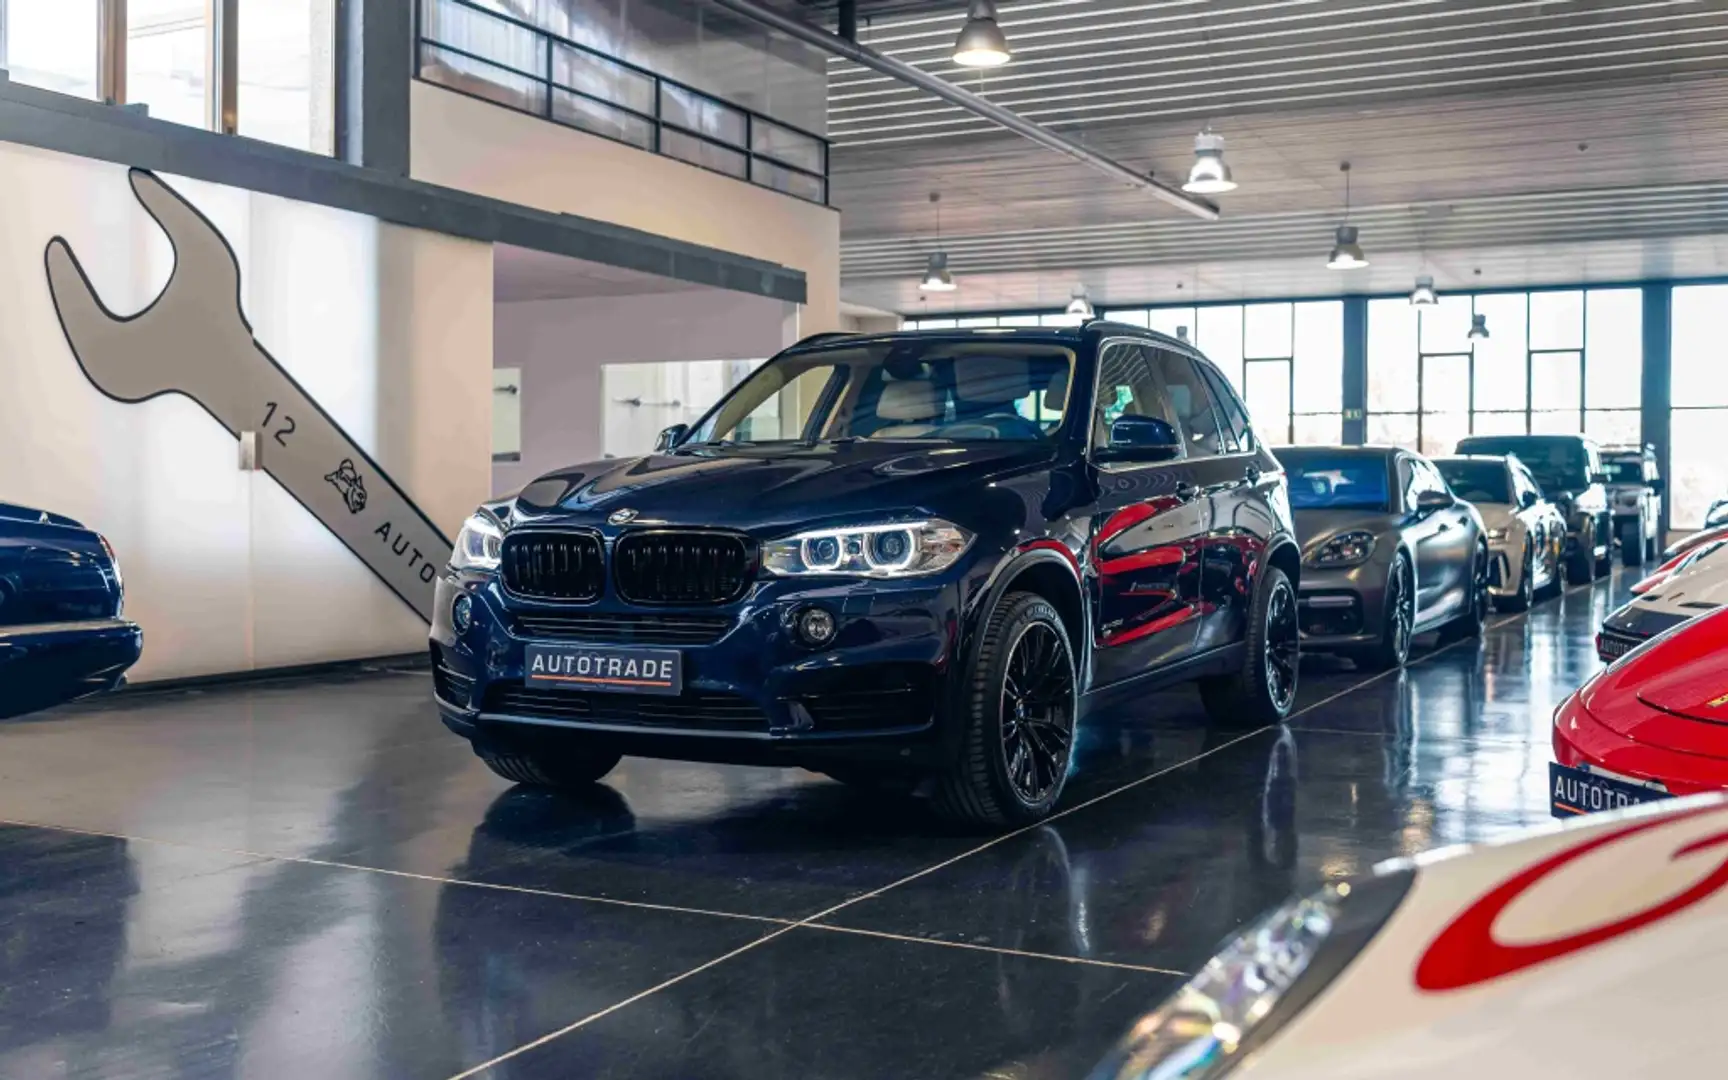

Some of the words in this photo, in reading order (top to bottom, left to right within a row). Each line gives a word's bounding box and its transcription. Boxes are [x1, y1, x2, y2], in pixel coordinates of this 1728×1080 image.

[261, 401, 297, 447] 12
[374, 521, 437, 584] AUTO
[531, 653, 673, 679] AUTOTRADE
